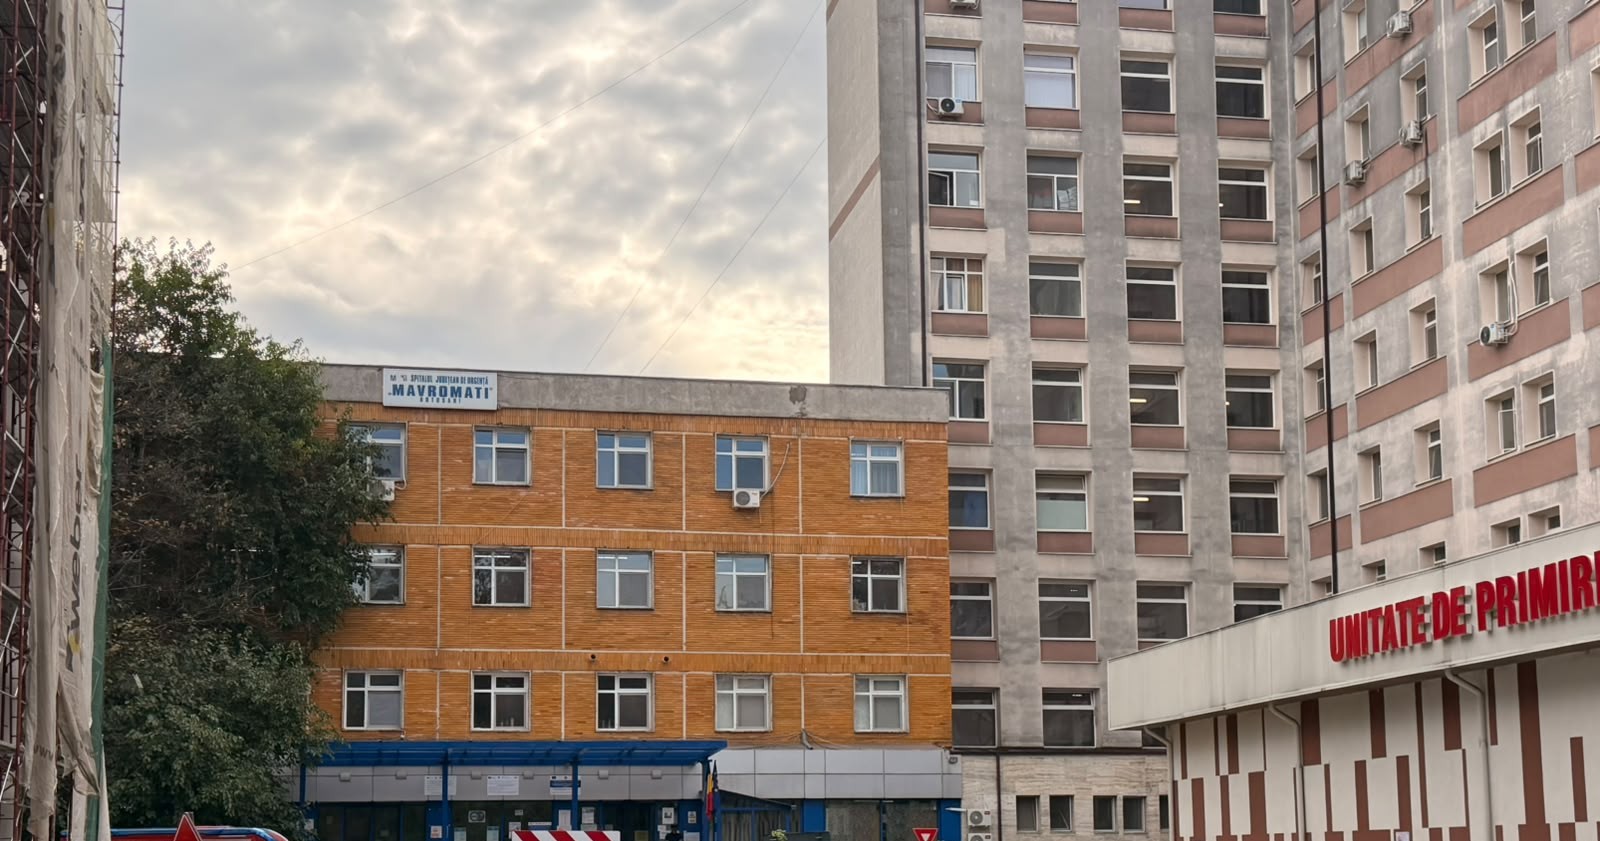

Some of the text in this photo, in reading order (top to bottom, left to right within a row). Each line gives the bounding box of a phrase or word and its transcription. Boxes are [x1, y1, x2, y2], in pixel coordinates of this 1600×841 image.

[410, 374, 433, 383] SPITALUL
[460, 376, 466, 384] DE
[1329, 595, 1428, 663] UNITATE
[1432, 585, 1470, 641] DE
